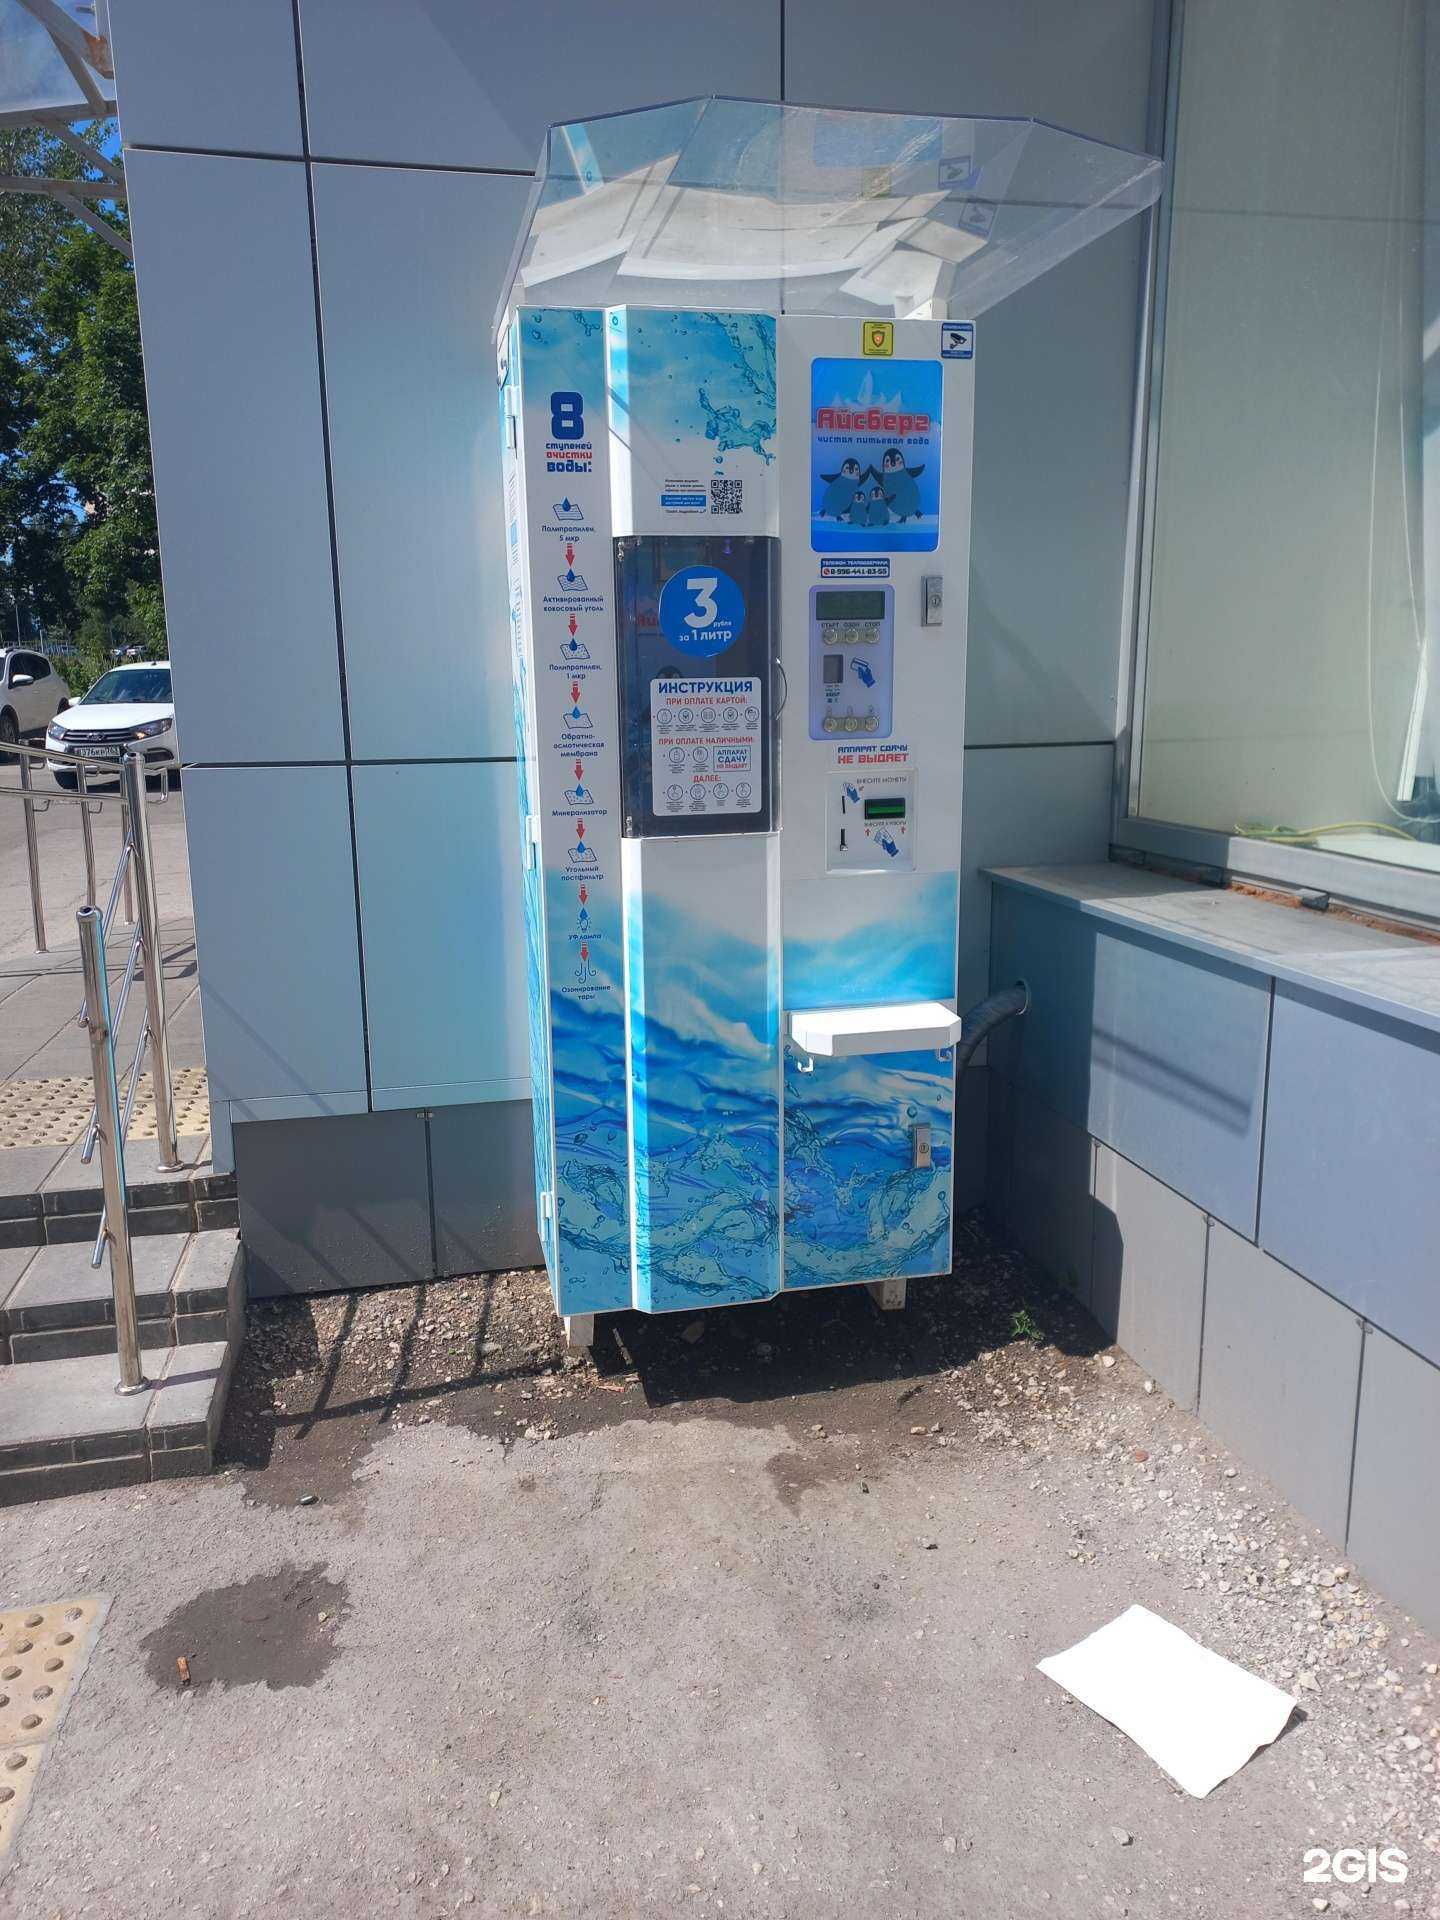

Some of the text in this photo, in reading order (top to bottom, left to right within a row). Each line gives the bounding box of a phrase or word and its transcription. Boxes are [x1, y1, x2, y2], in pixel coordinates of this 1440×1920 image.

[551, 392, 584, 439] 8
[817, 409, 931, 435] Айсберг
[545, 442, 592, 450] ступеней
[546, 451, 592, 459] очистки
[546, 460, 593, 472] воды:
[543, 595, 604, 604] Активированный
[684, 578, 717, 628] 3
[692, 629, 697, 640] 1
[700, 630, 732, 641] литр
[658, 681, 753, 694] ИНСТРУКЦИЯ
[666, 697, 682, 705] ПРИ
[685, 697, 713, 705] ОПЛАТЕ
[658, 738, 673, 746] ПРИ
[675, 737, 704, 745] ОПЛАТЕ
[838, 745, 877, 753] АППАРАТ
[718, 755, 747, 763] СДАЧУ
[838, 753, 908, 764] НЕ ВЫДАЕТ
